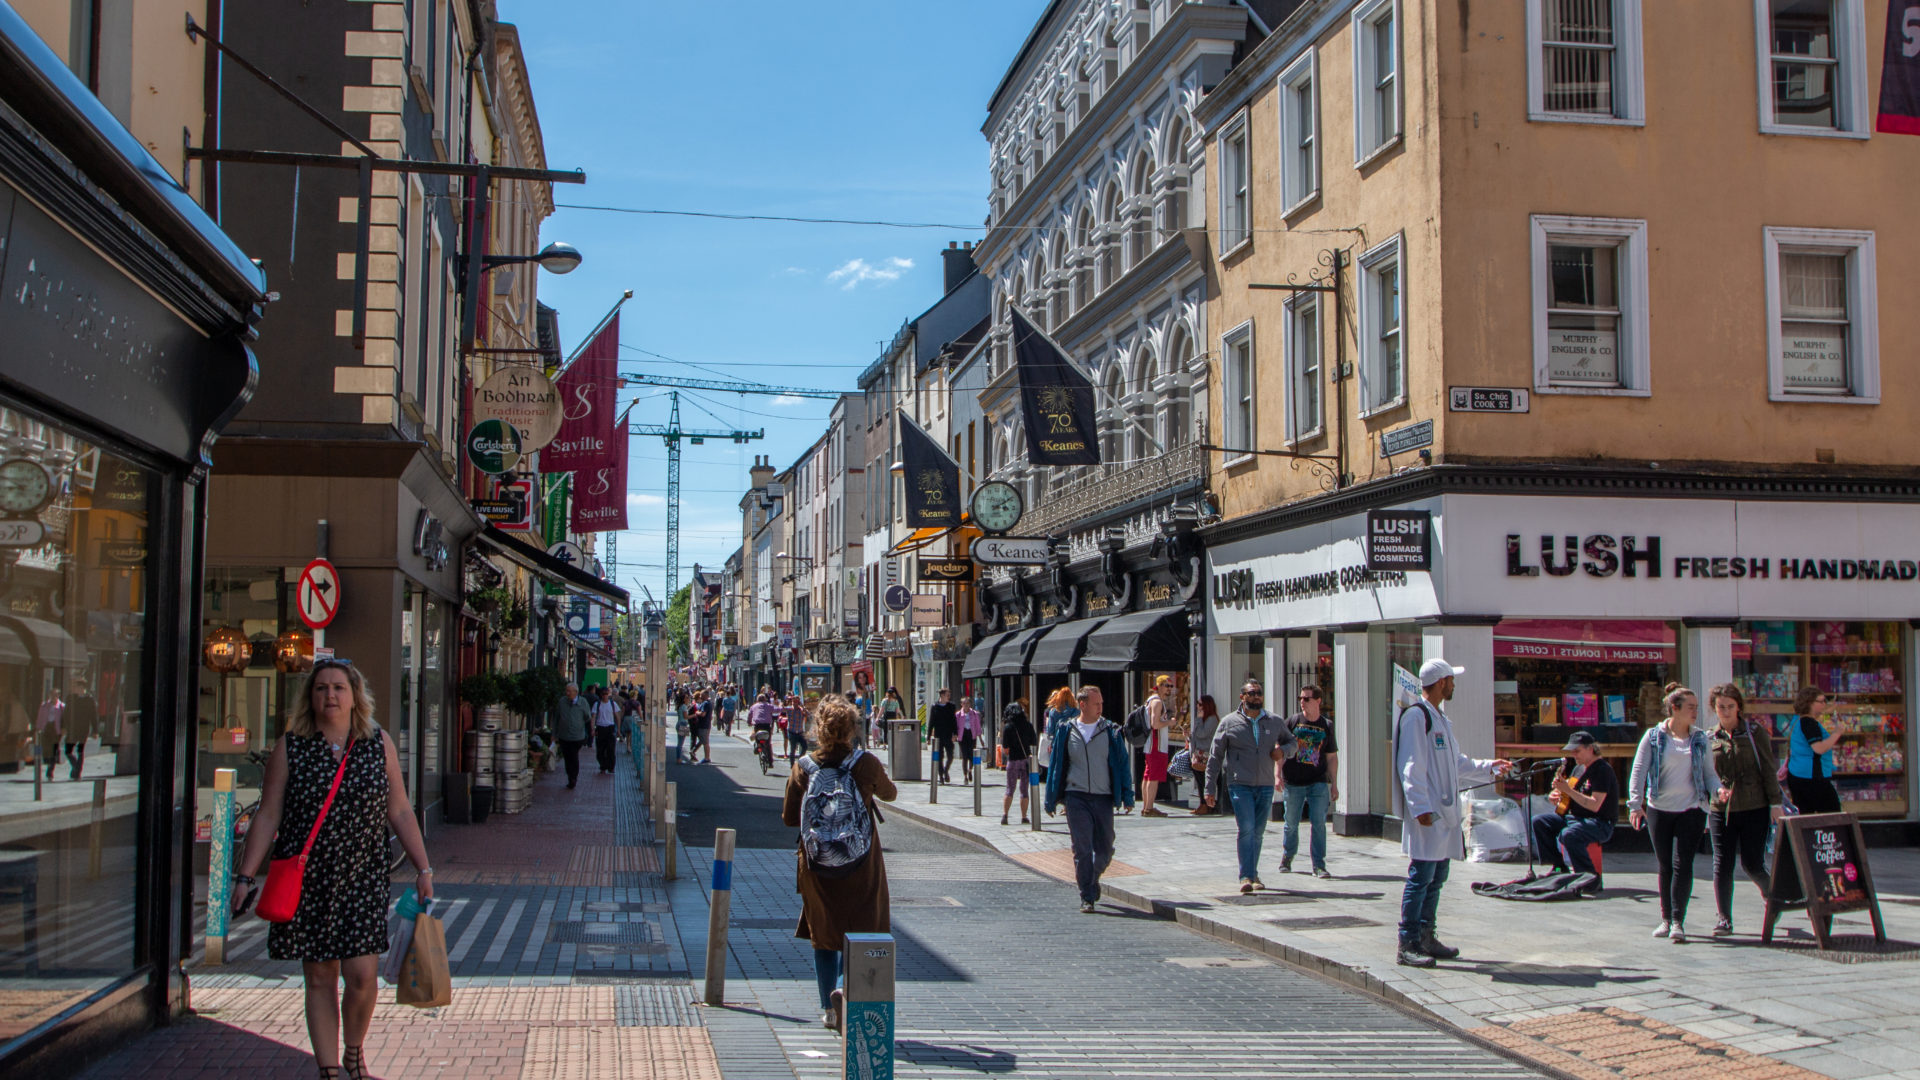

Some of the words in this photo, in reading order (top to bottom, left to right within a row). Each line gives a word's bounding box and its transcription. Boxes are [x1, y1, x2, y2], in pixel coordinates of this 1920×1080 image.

[1562, 335, 1598, 343] MURPHY
[1793, 341, 1827, 349] MURPHY
[1551, 345, 1587, 354] ENGLISH
[1783, 352, 1817, 360] ENGLISH
[508, 374, 530, 387] An
[487, 407, 549, 416] Traditional
[1048, 413, 1072, 434] 70
[473, 437, 517, 454] Carlsberg
[551, 436, 604, 453] Saville
[1039, 440, 1085, 451] Keanes
[925, 490, 942, 504] 70
[492, 506, 515, 514] MUSIC
[579, 506, 619, 519] Saville
[919, 509, 951, 518] Keanes
[1372, 519, 1423, 534] LUSH
[987, 543, 1045, 559] Keanes
[1373, 545, 1422, 553] HANDMADE
[1373, 554, 1424, 562] COSMETICS
[1506, 533, 1662, 578] LUSH
[1674, 556, 1770, 579] FRESH
[1780, 557, 1920, 581] HANDMAD
[1213, 567, 1253, 600] LUSH
[1255, 581, 1283, 600] FRESH
[1285, 570, 1338, 596] HANDMADE
[1144, 580, 1170, 602] Keanes
[1814, 830, 1836, 843] Tea
[1822, 842, 1834, 850] and
[1816, 850, 1845, 864] Coffee
